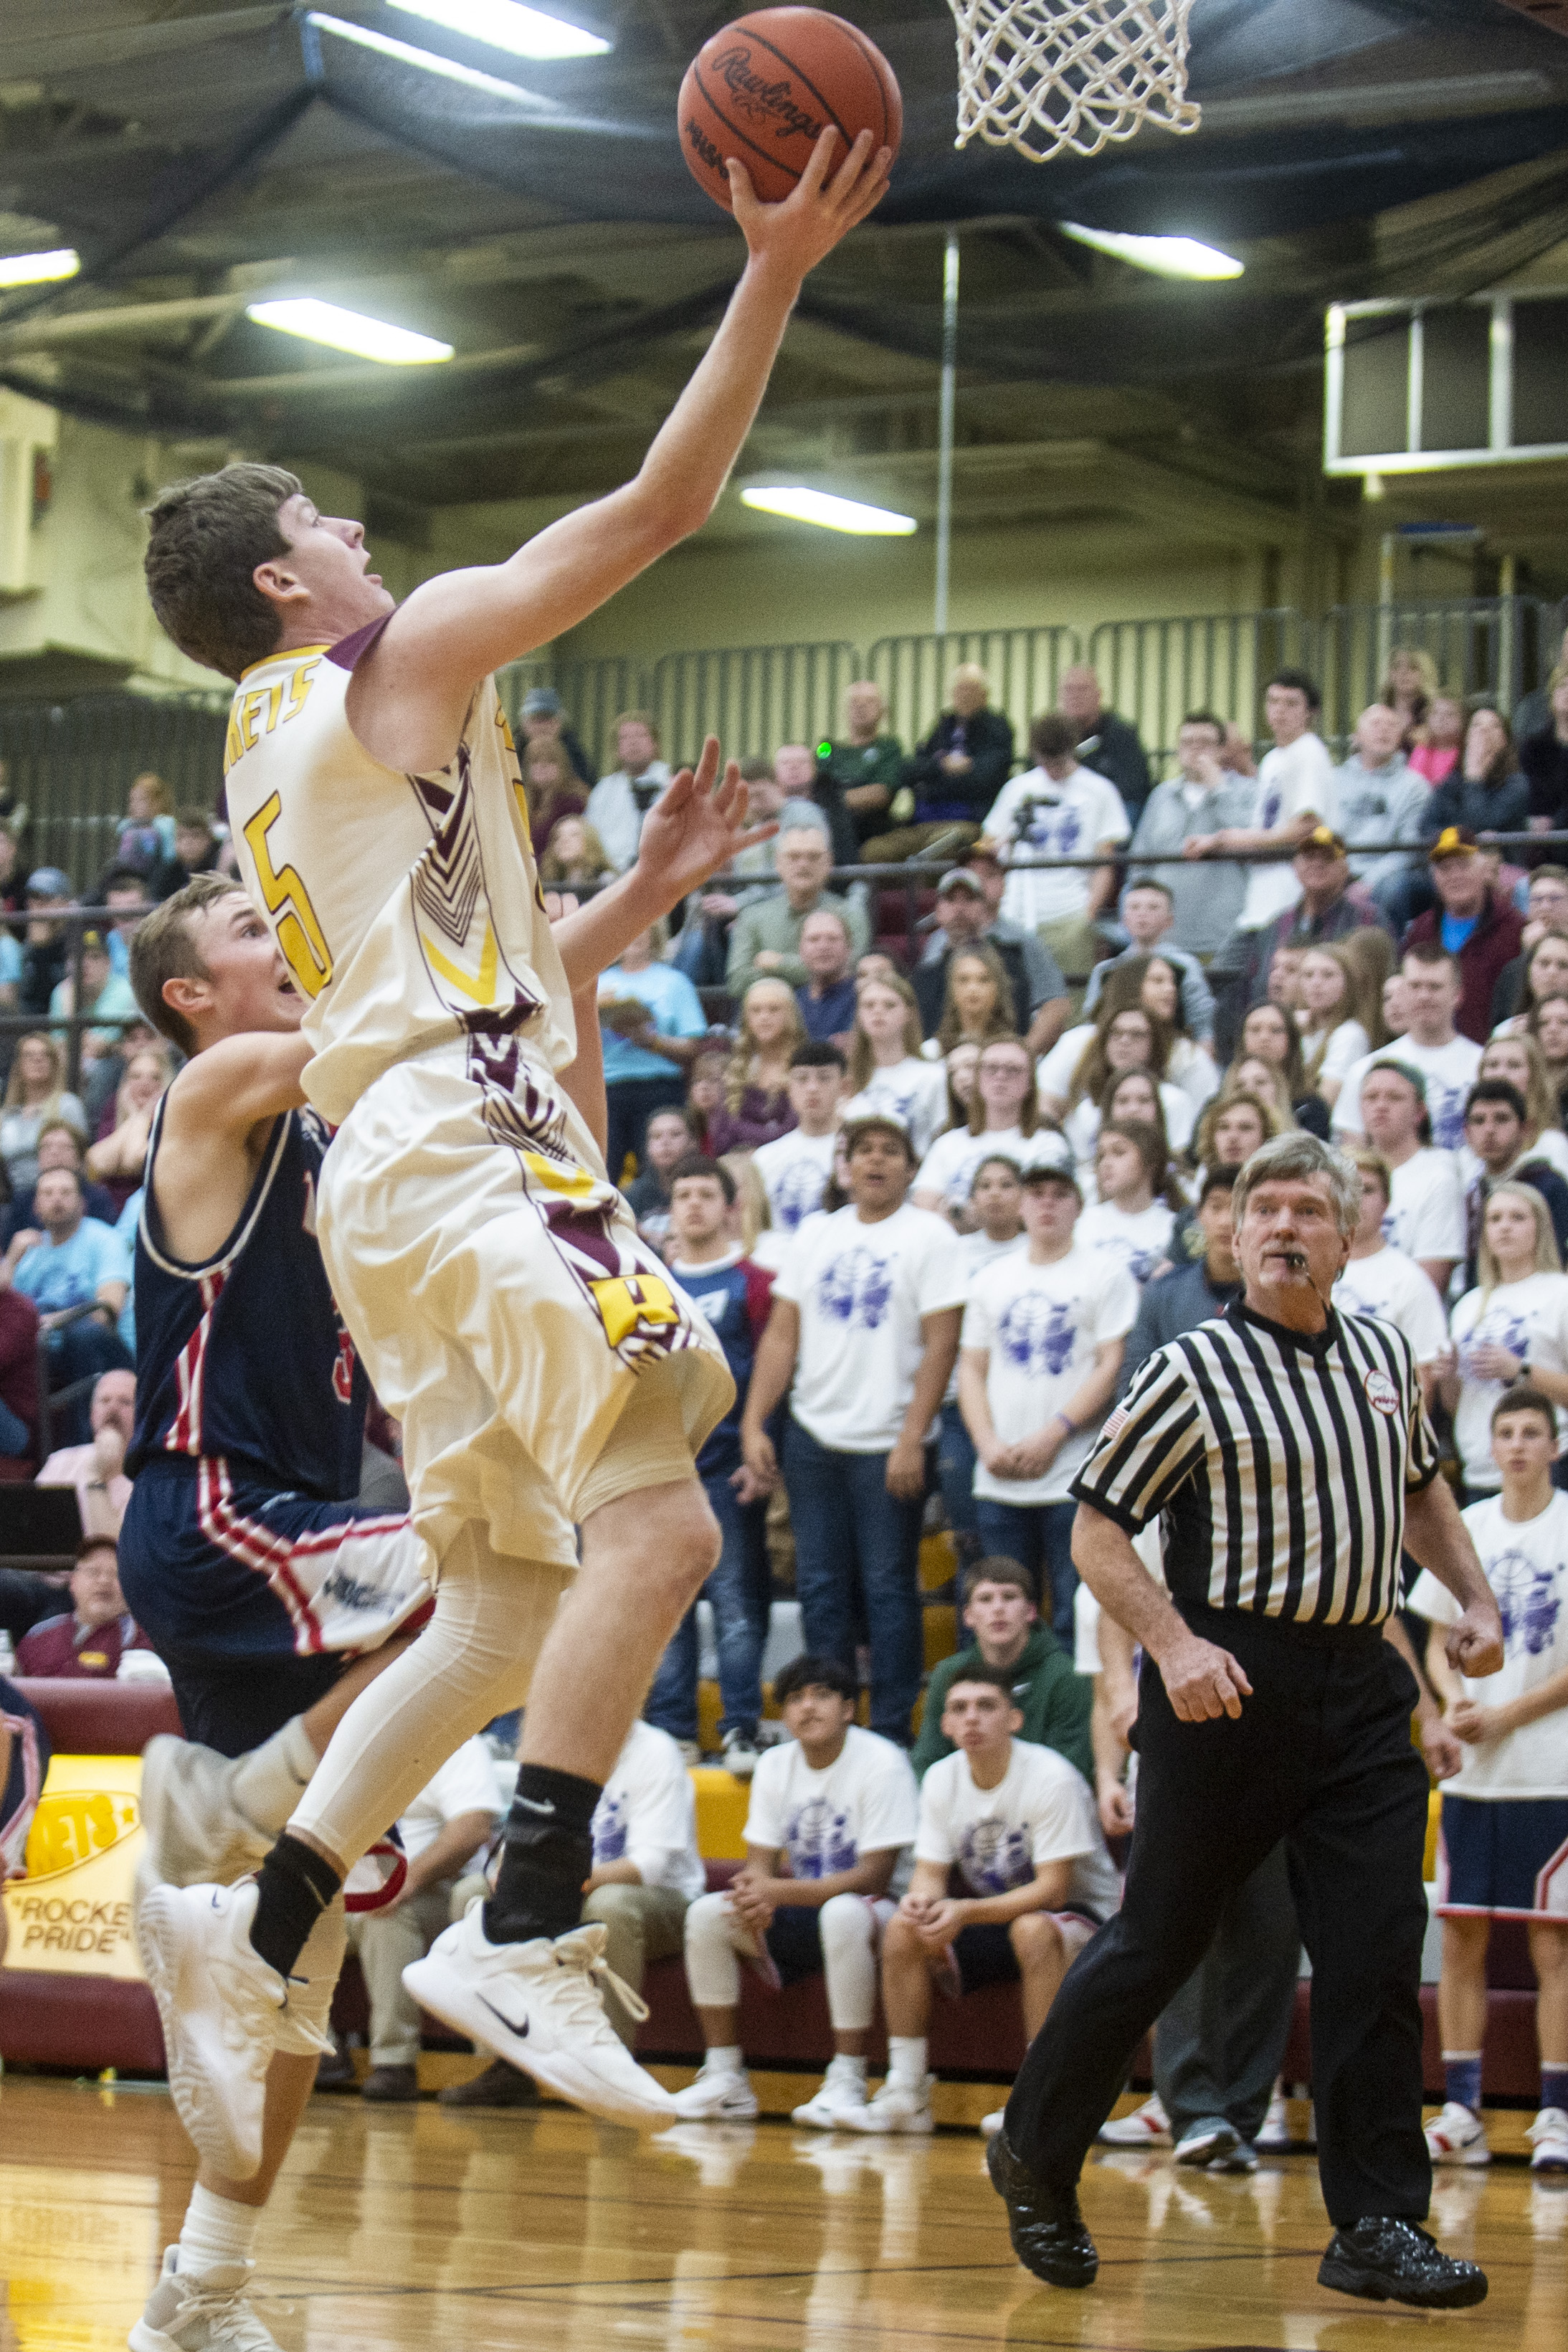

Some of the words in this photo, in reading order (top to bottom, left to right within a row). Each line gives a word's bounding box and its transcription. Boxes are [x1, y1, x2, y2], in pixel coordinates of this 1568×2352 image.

[712, 47, 822, 140] Rawlings
[224, 658, 323, 776] KETS
[244, 789, 333, 1000] 5
